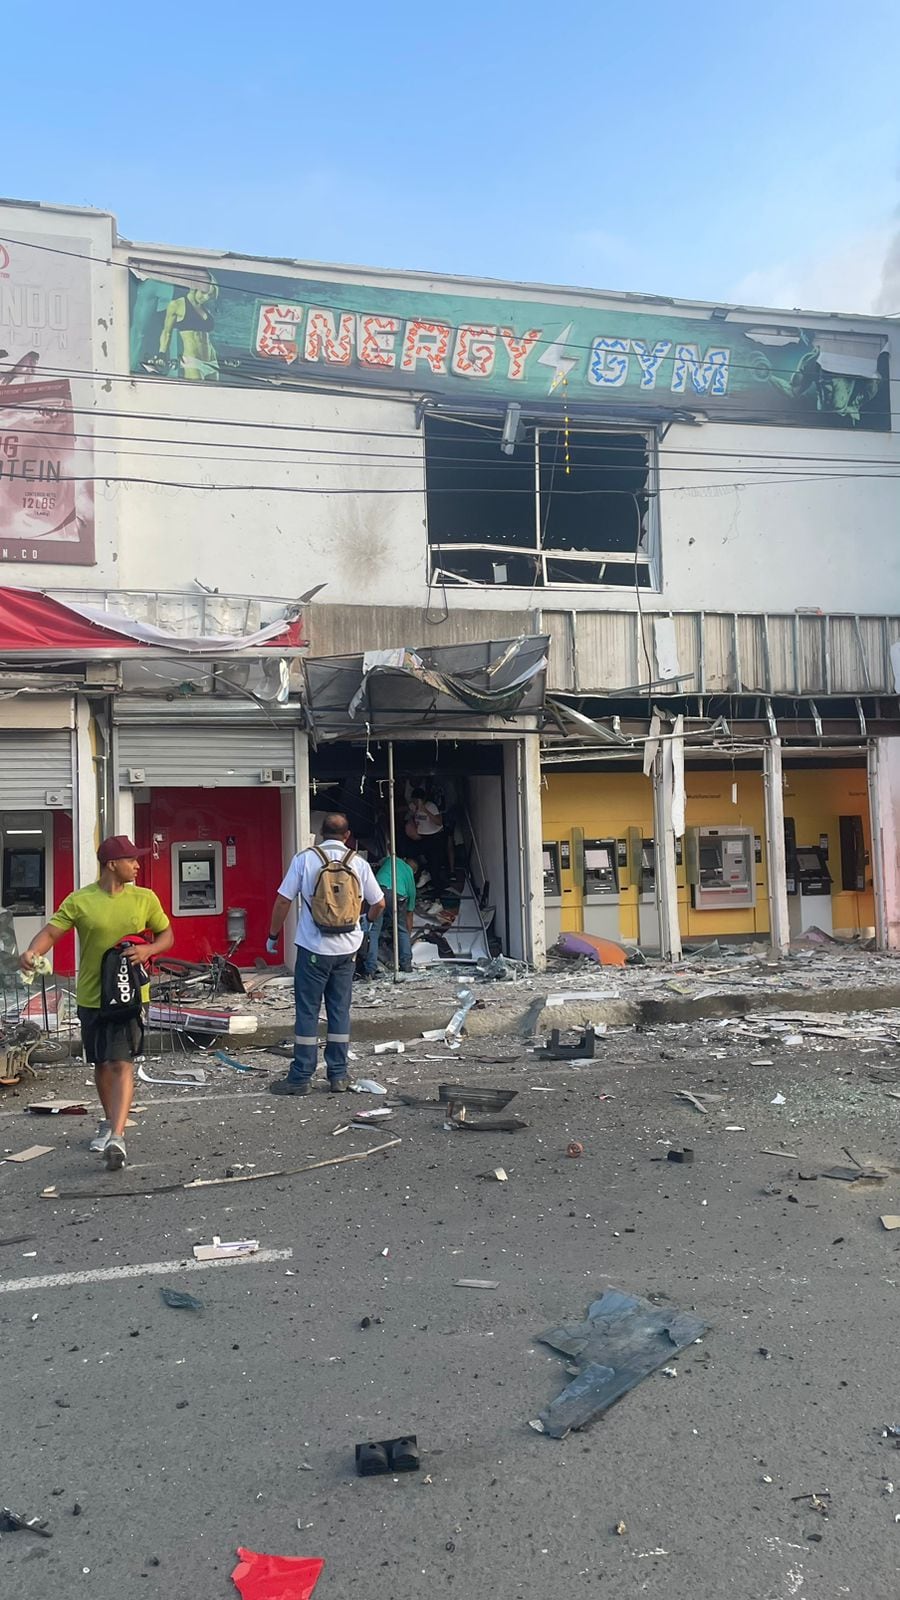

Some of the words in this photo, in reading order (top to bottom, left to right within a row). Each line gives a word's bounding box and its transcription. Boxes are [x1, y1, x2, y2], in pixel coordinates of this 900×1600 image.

[255, 304, 543, 380] ENERGY
[587, 336, 731, 396] GYM
[0, 436, 19, 458] G
[0, 460, 61, 483] TEIN
[117, 957, 131, 1002] adidas
